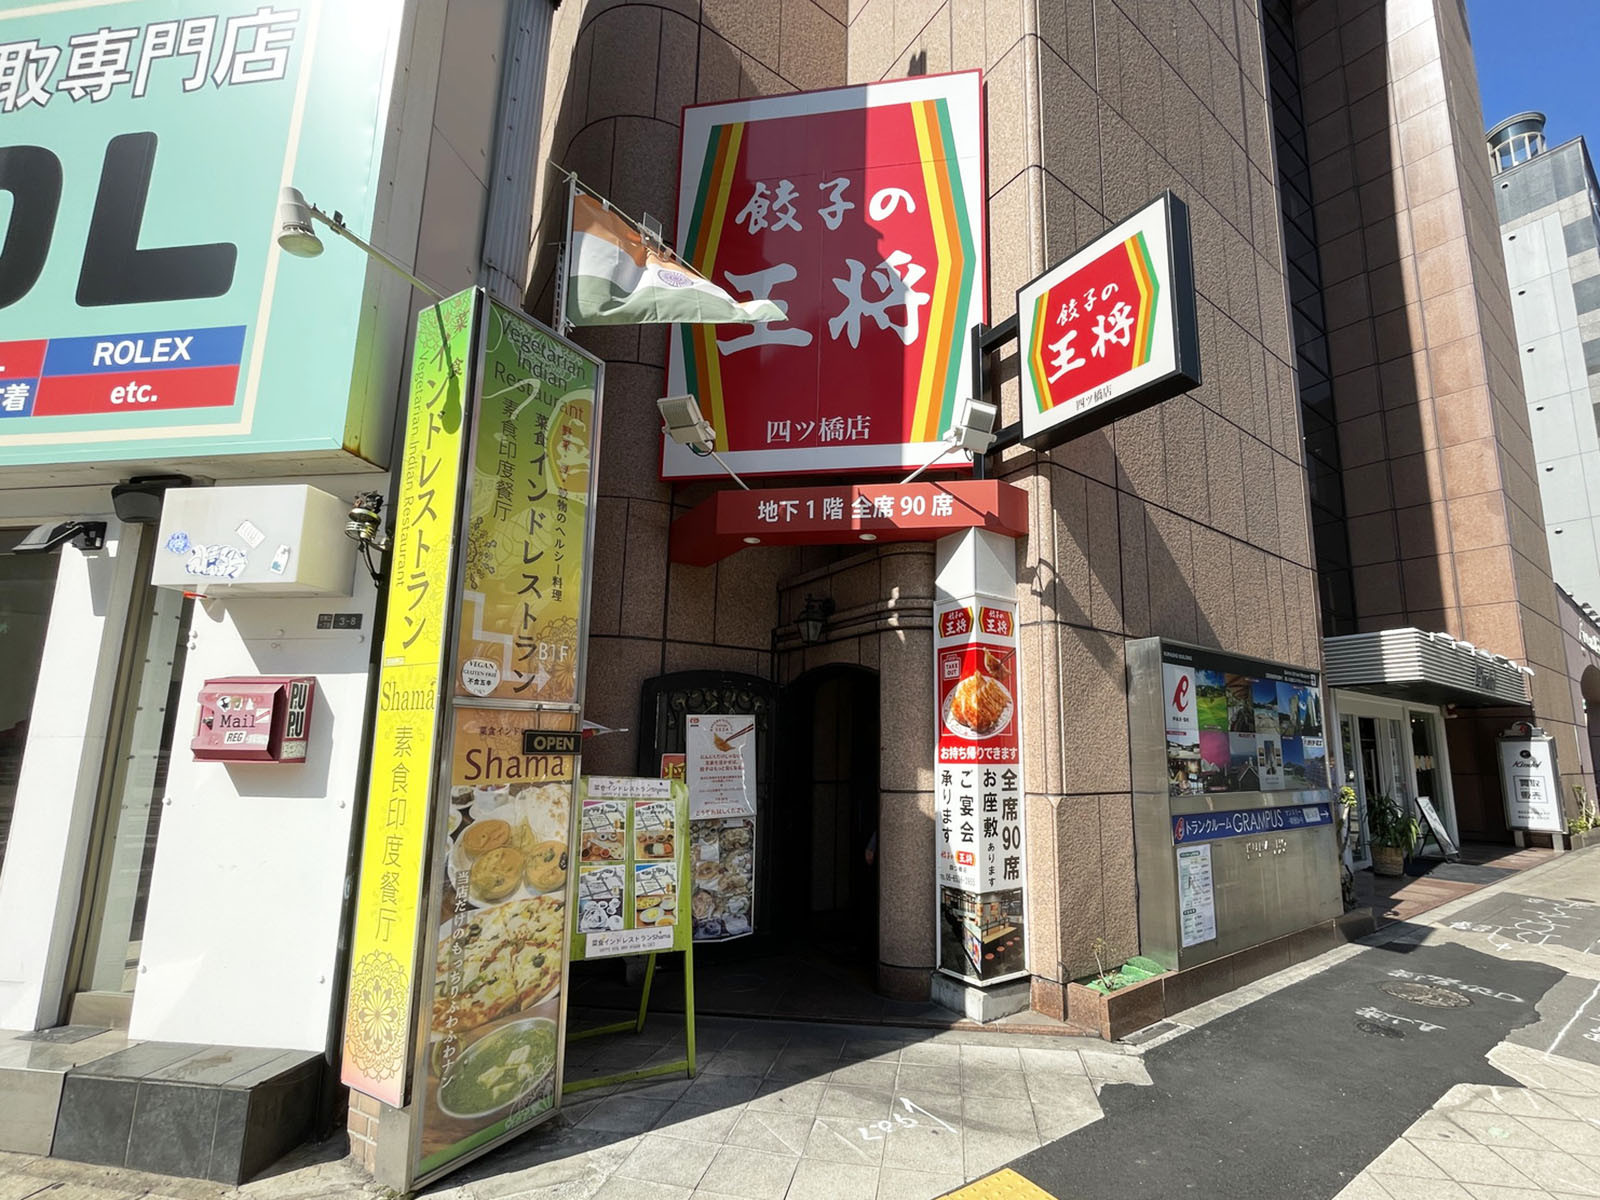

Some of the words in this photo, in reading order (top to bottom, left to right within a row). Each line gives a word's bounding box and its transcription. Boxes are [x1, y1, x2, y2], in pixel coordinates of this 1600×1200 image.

[0, 7, 300, 113] 取専門店
[735, 178, 916, 235] 餃子の
[716, 250, 930, 356] 王将
[1056, 283, 1119, 326] 餃子の
[92, 336, 194, 366] ROLEX
[502, 320, 586, 381] Vegetarian
[1047, 301, 1135, 384] 王将
[495, 361, 584, 420] Restaurant
[518, 350, 567, 392] Indian
[0, 383, 30, 412] 着
[110, 380, 158, 405] etc.
[411, 351, 428, 437] Vegetarian
[1075, 384, 1112, 412] 四ツ橋店
[767, 415, 872, 443] 四ツ橋店
[405, 440, 419, 492] Indian
[396, 496, 415, 587] Restaurant
[512, 412, 550, 694] 菜食インドレストラン
[945, 619, 967, 636] 王将
[948, 611, 964, 620] 餃子の
[986, 618, 1009, 635] 王将
[988, 611, 1004, 620] 餃子の
[540, 642, 569, 661] B1F
[220, 714, 255, 728] Mail
[464, 747, 565, 780] Shama
[533, 736, 574, 751] OPEN
[940, 745, 1018, 760] お持ち帰りできます
[941, 769, 953, 843] 承ります
[960, 770, 974, 843] ご宴会
[1001, 768, 1021, 881] 全席90席
[1185, 818, 1232, 836] トランクルーム
[1232, 809, 1284, 833] GRAMPUS
[375, 726, 413, 942] 素食印度餐厅
[441, 871, 470, 1089] 当店だけのもっちりふわふわナン
